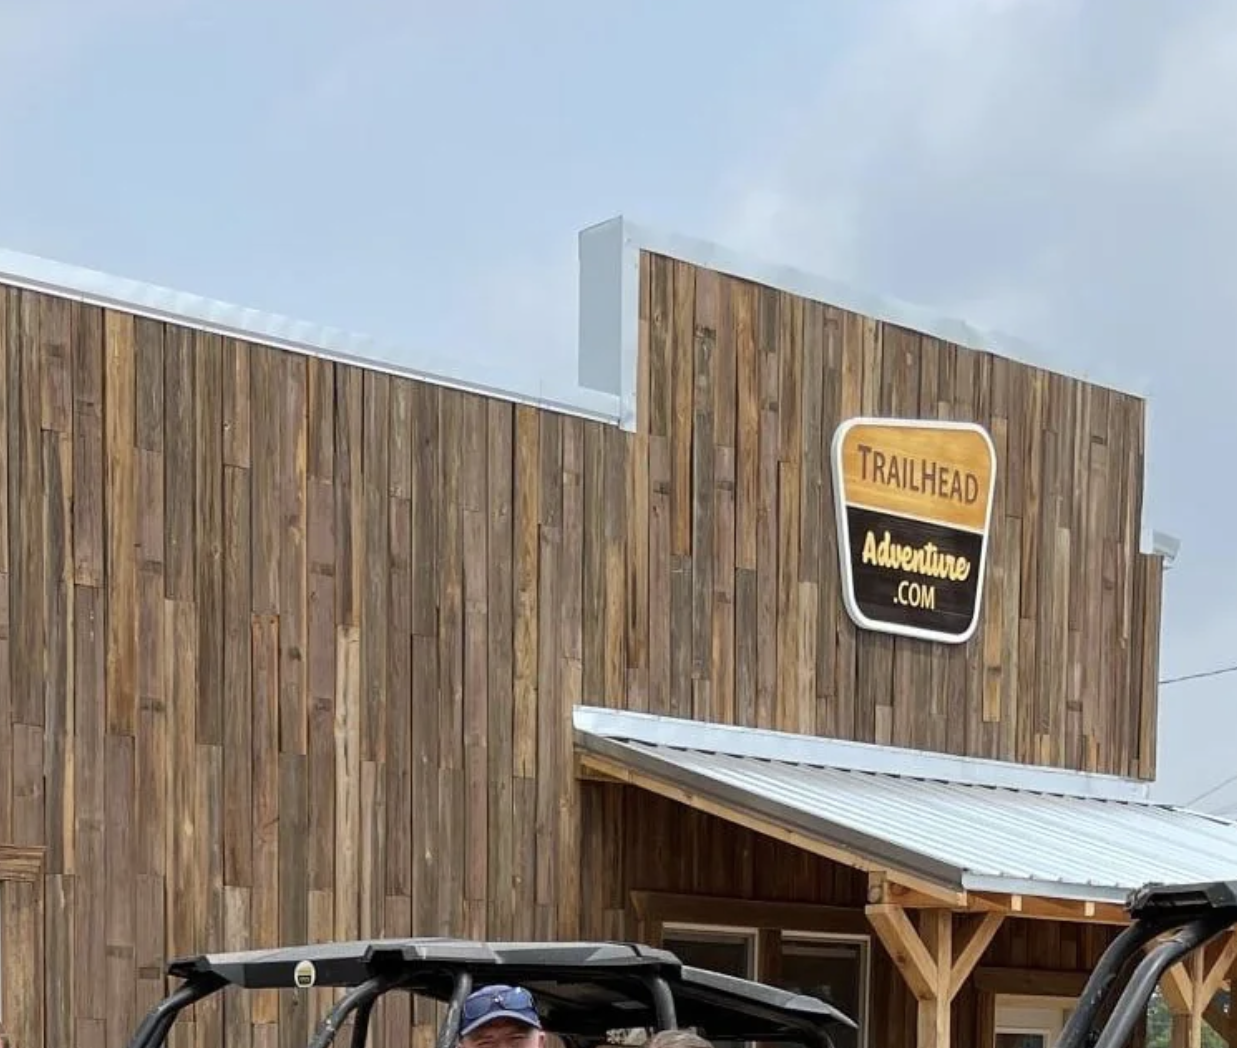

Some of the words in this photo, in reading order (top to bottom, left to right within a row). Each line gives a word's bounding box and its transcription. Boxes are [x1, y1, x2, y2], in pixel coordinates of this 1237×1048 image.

[857, 443, 980, 506] TRAILHEAD
[861, 529, 972, 583] Adventure
[892, 579, 937, 611] .COM
